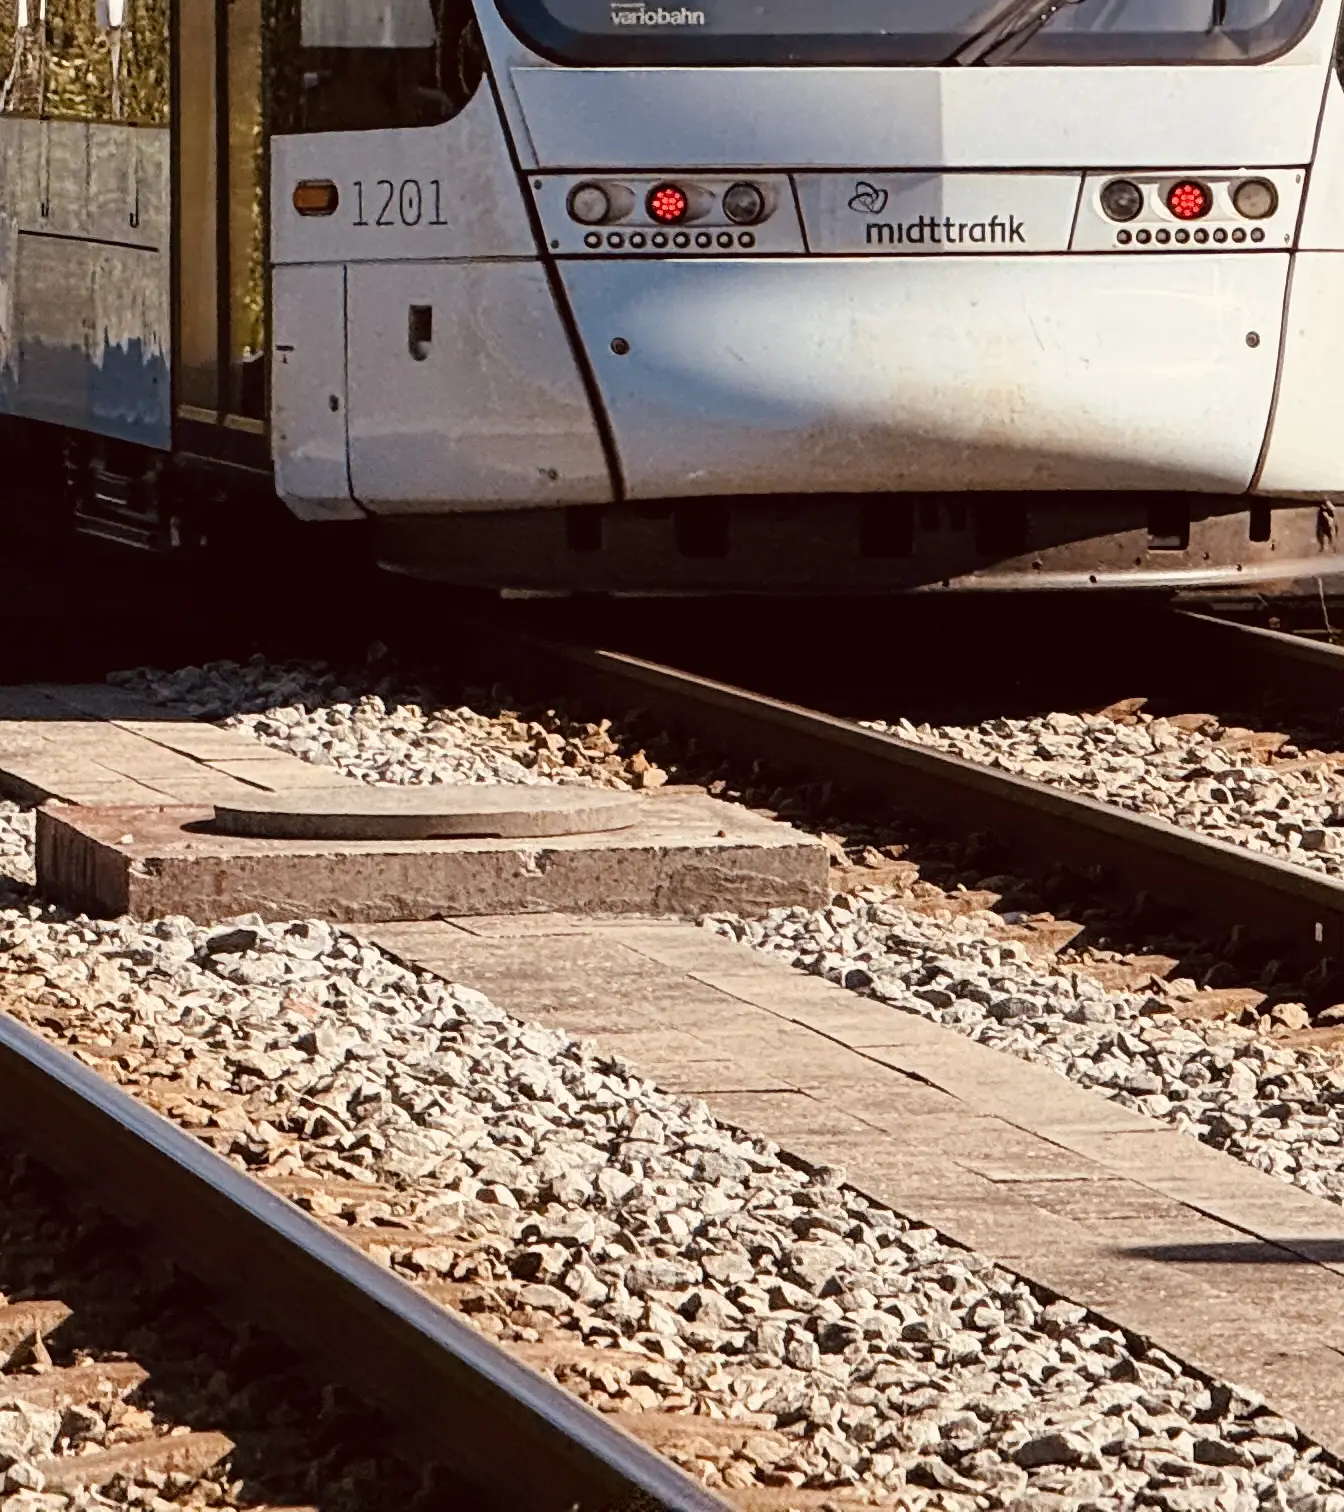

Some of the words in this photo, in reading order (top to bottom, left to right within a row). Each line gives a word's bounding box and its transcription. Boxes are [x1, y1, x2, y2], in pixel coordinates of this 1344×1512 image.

[611, 7, 705, 25] variobahn
[352, 179, 448, 226] 1201
[866, 215, 1026, 245] midttrafik
